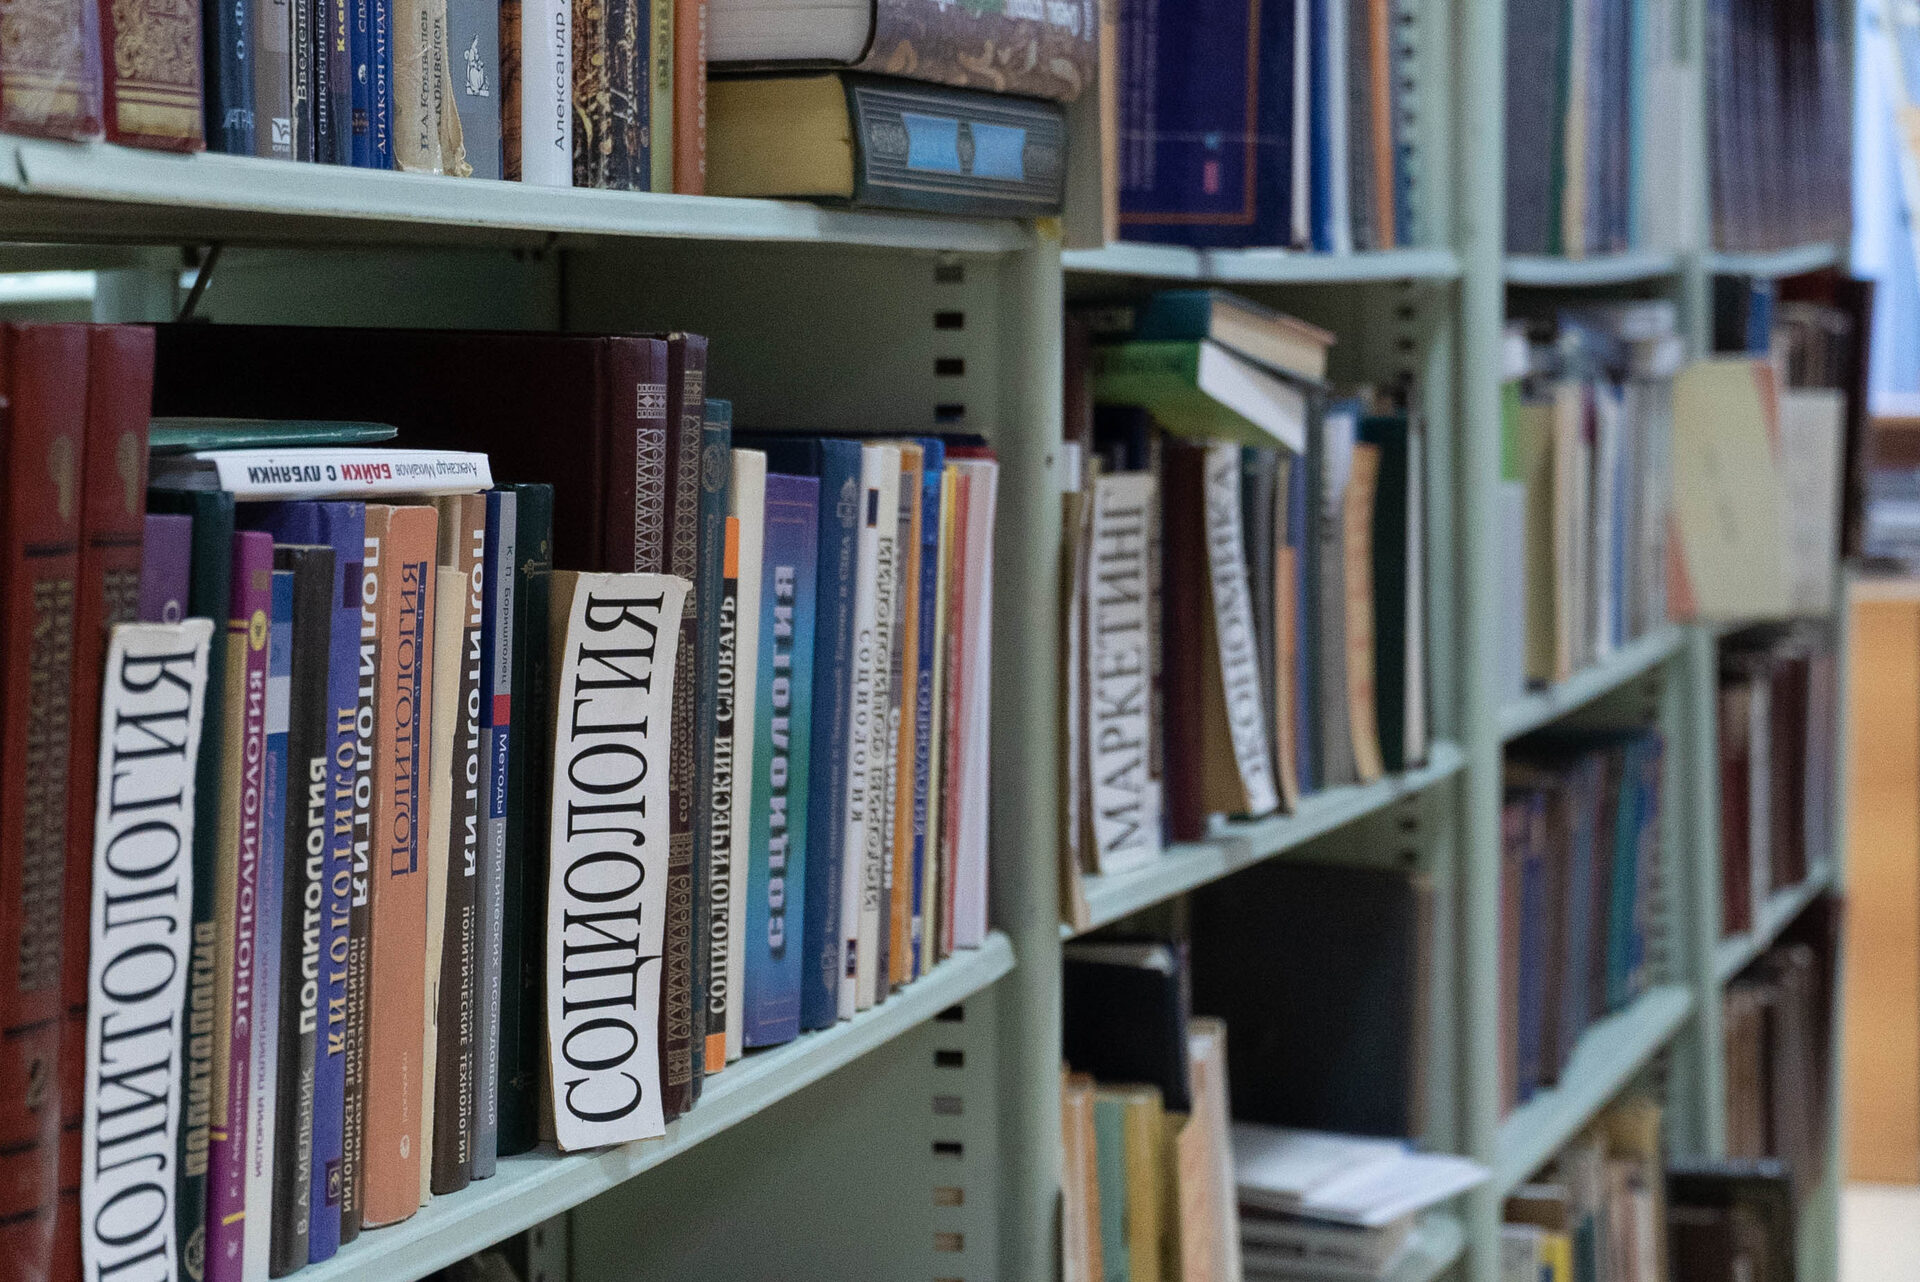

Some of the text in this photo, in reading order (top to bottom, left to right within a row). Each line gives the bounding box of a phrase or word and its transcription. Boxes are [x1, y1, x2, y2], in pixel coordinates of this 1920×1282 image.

[376, 64, 387, 155] ДИАКОН
[552, 12, 566, 153] Александр
[247, 465, 322, 485] ЛУБЯНКИ
[327, 465, 337, 482] С
[340, 463, 392, 485] БАЙКИ
[351, 535, 381, 908] ПОЛИТОЛОГИЯ
[390, 560, 418, 878] ПОЛИТОЛОГИЯ
[464, 527, 484, 878] ПОЛИТОЛОГИЯ
[714, 596, 735, 722] СЛОВАРЬ
[1097, 489, 1144, 855] МАРКЕТИНГ
[234, 669, 263, 1039] ЭТНОПОЛИТОЛОГИЯ
[299, 755, 328, 1036] ПОЛИТОЛОГИЯ
[326, 706, 358, 1058] ПОЛИТОЛОГИЯ
[487, 732, 508, 1127] Методы политических исследований
[563, 590, 664, 1122] СОЦИОЛОГИЯ
[296, 1066, 314, 1236] В. А. МЕЛЬНИК
[342, 936, 359, 1213] ПОЛИТИЧЕСКИЕ ТЕХНОЛОГИИ
[458, 904, 471, 1165] ПОЛИТИЧЕСКИЕ ТЕХНОЛОГИИ
